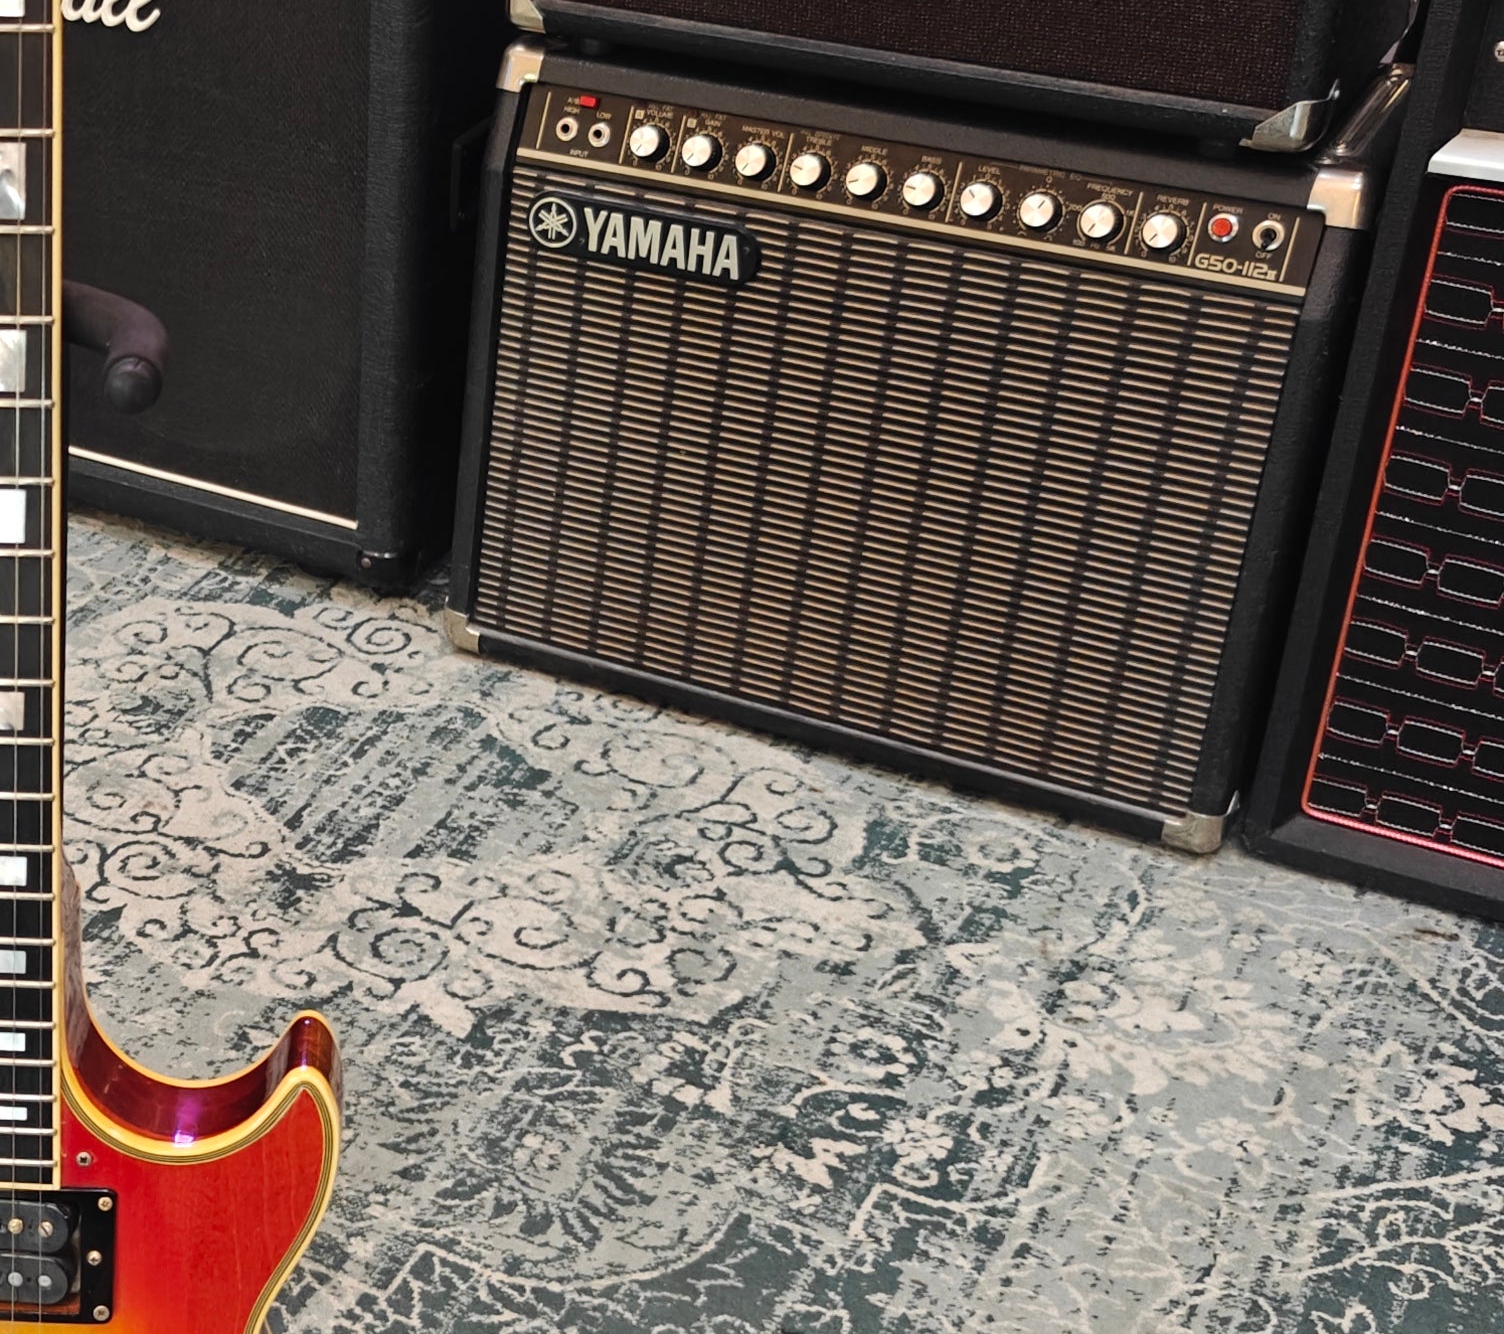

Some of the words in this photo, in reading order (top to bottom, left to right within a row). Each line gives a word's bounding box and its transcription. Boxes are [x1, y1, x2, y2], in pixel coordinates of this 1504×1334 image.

[1086, 182, 1134, 197] FREQUENCY
[1156, 194, 1190, 207] REVERB
[1212, 203, 1244, 215] POWER
[1267, 212, 1282, 221] ON
[583, 207, 741, 281] YAMAHA
[1255, 251, 1273, 260] OFF
